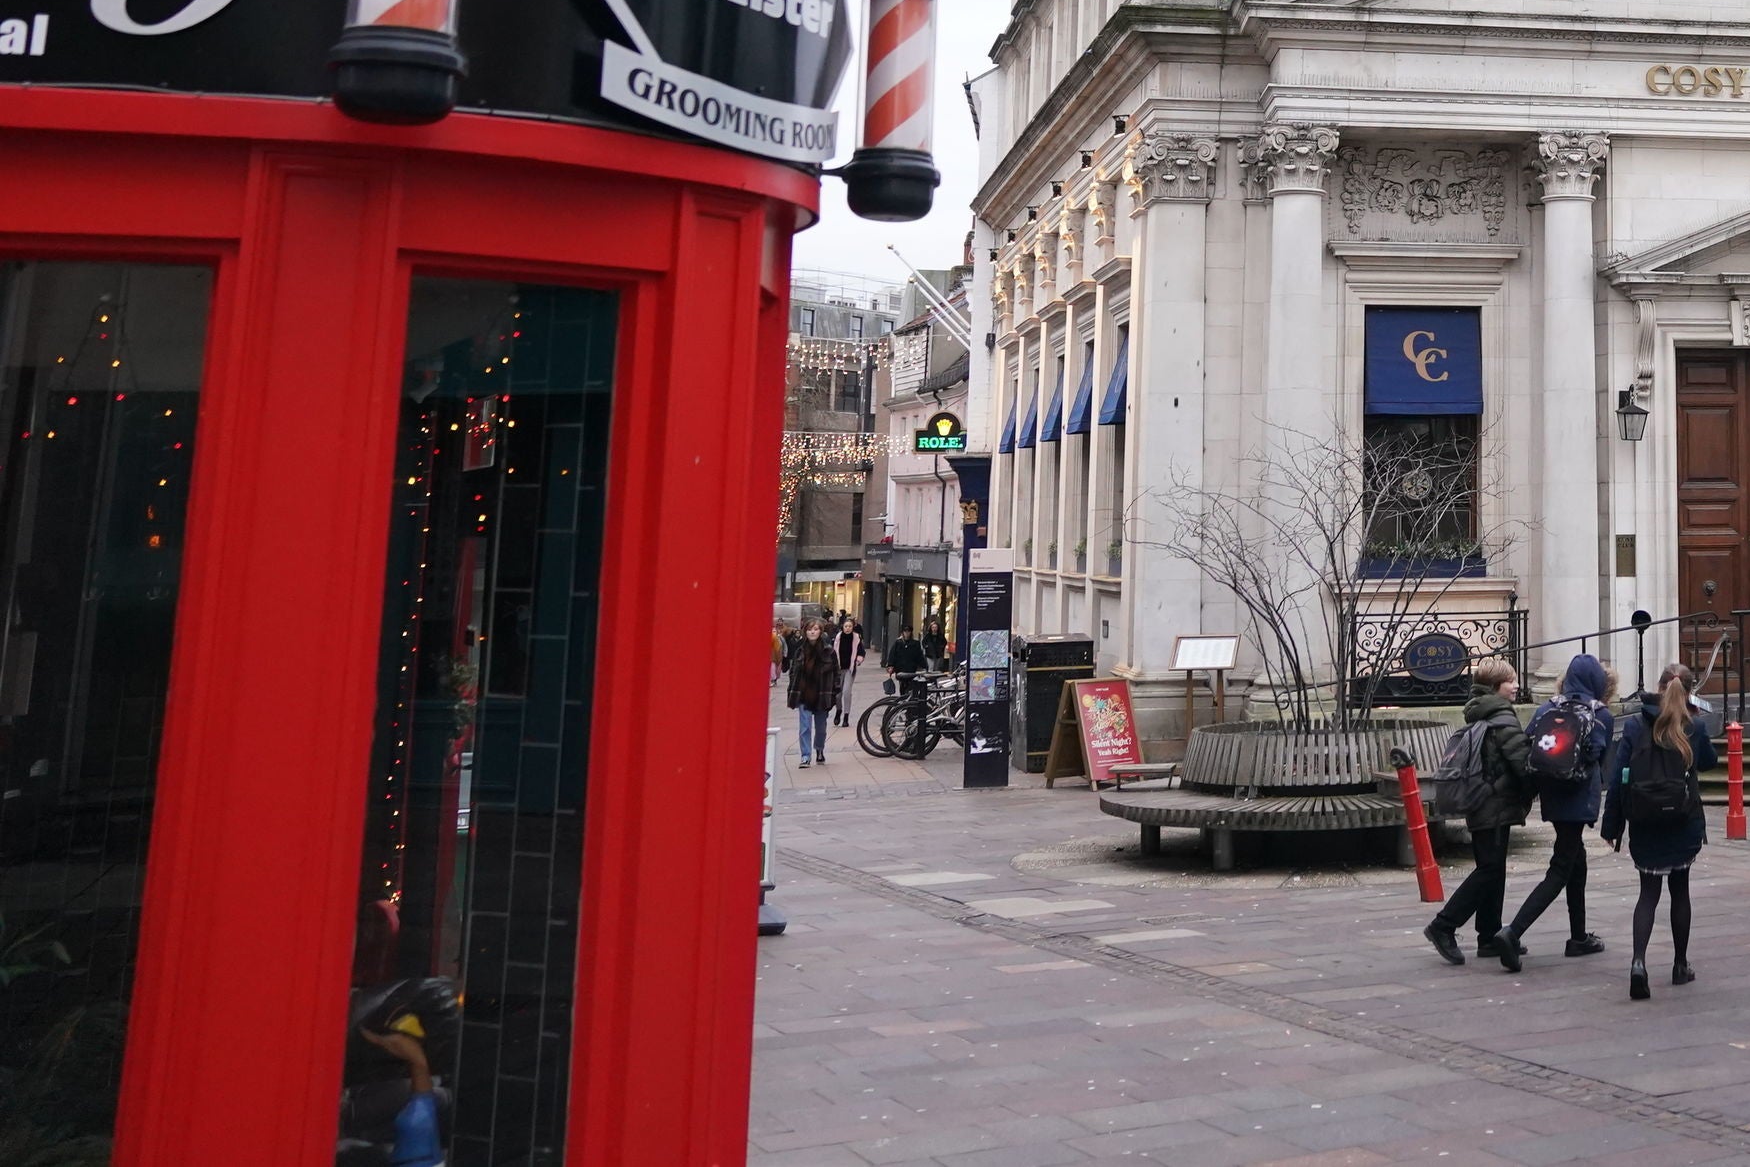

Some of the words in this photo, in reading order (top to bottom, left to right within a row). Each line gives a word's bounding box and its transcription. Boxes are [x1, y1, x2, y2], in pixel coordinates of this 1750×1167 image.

[1645, 63, 1749, 99] COSY
[627, 67, 785, 146] GROOMING
[918, 436, 964, 449] ROLE
[1417, 645, 1454, 657] COSY
[1090, 738, 1110, 749] Silent
[1110, 737, 1132, 748] Night?
[1097, 747, 1111, 756] Yeah
[1112, 746, 1129, 756] Right!
